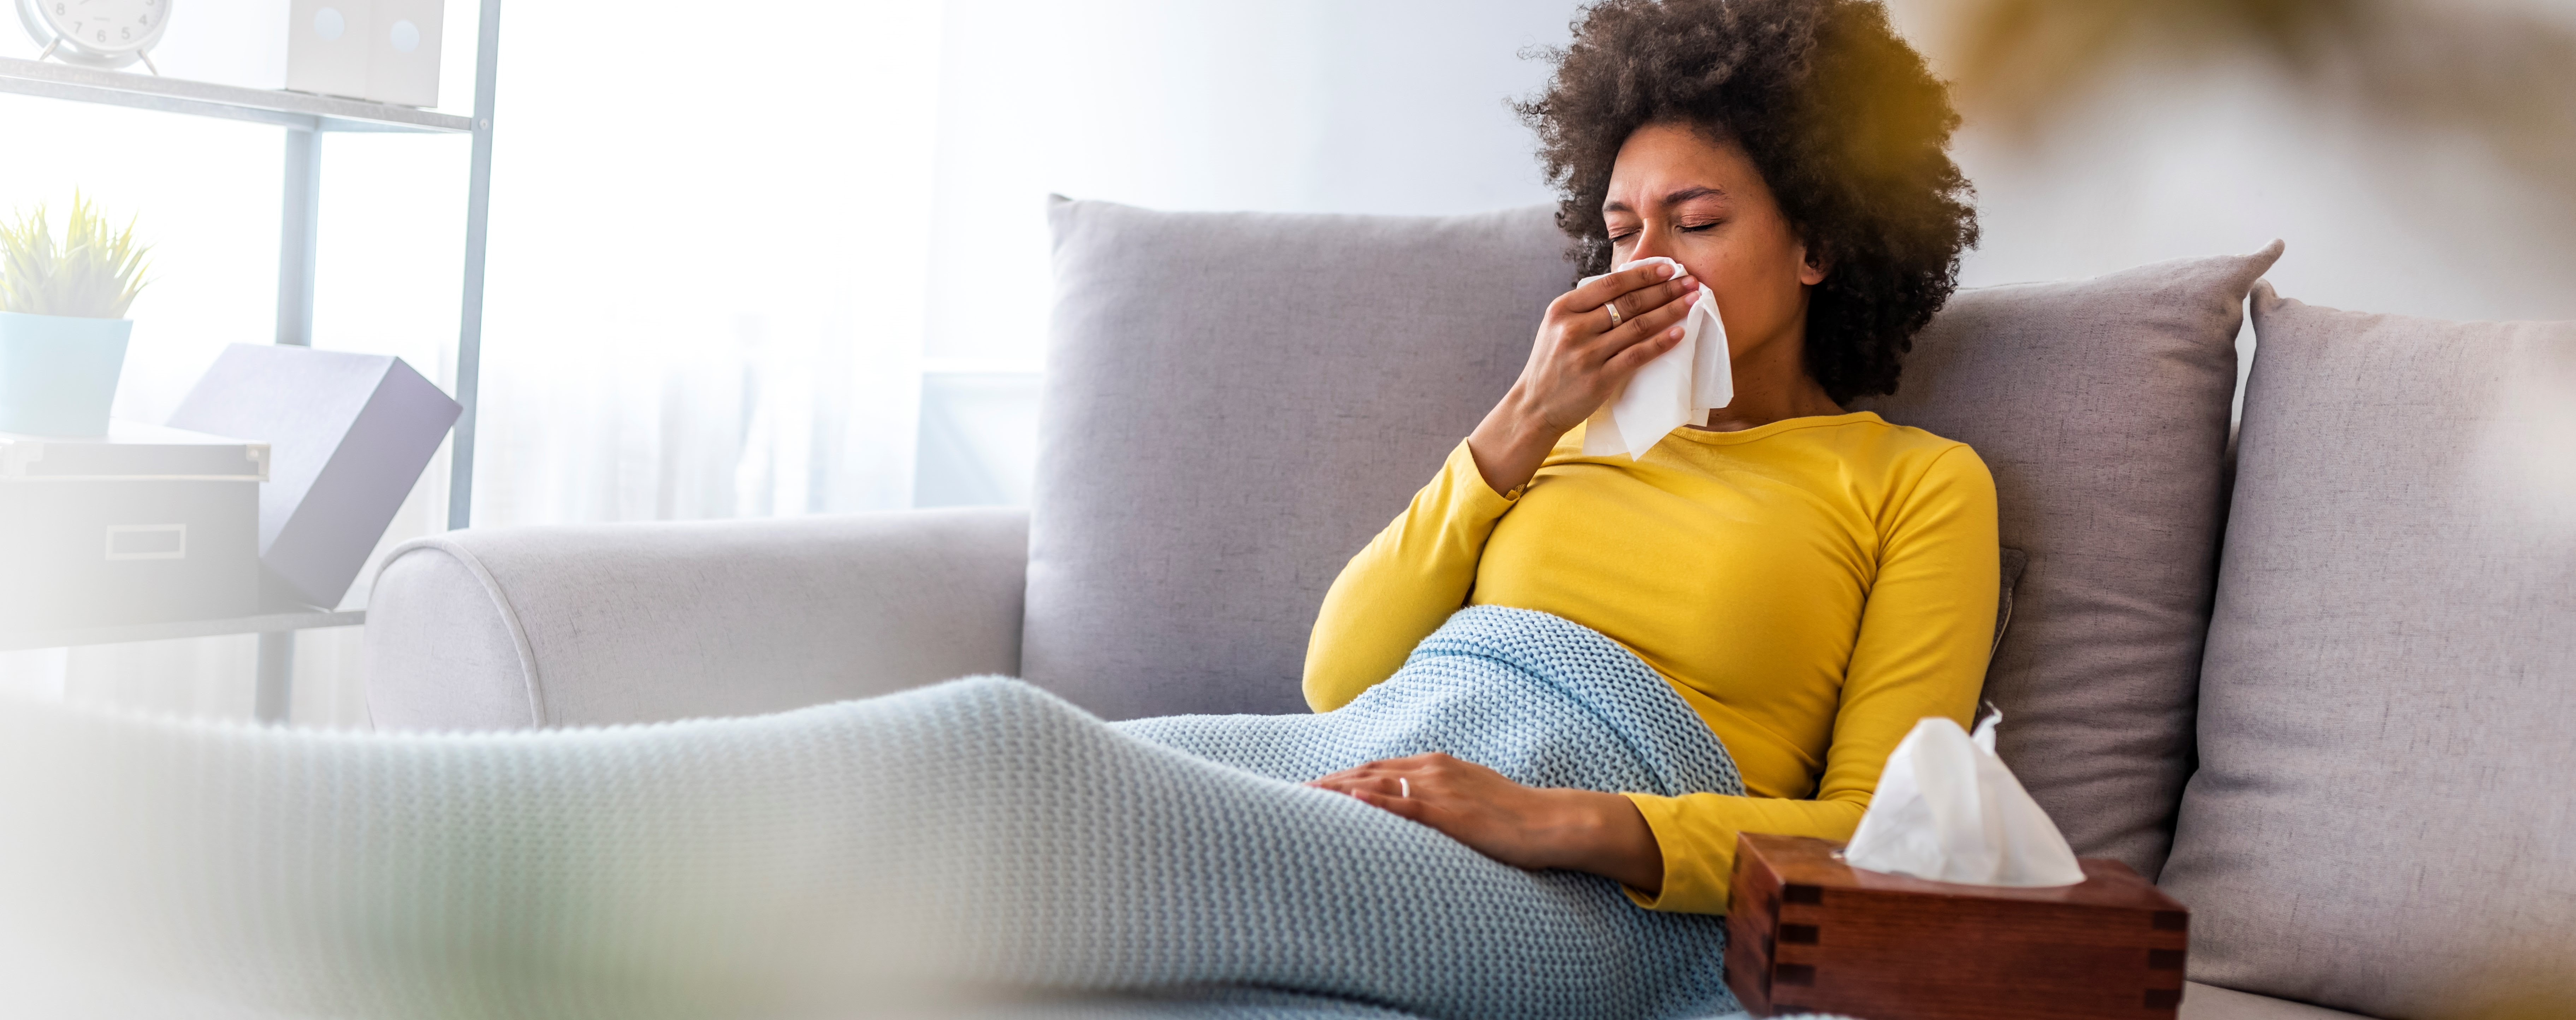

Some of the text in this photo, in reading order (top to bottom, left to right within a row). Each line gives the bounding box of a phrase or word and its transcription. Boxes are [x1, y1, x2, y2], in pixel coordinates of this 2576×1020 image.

[55, 3, 65, 16] 8
[138, 14, 147, 26] 4
[74, 21, 83, 34] 7
[121, 26, 130, 40] 5
[96, 30, 106, 42] 6
